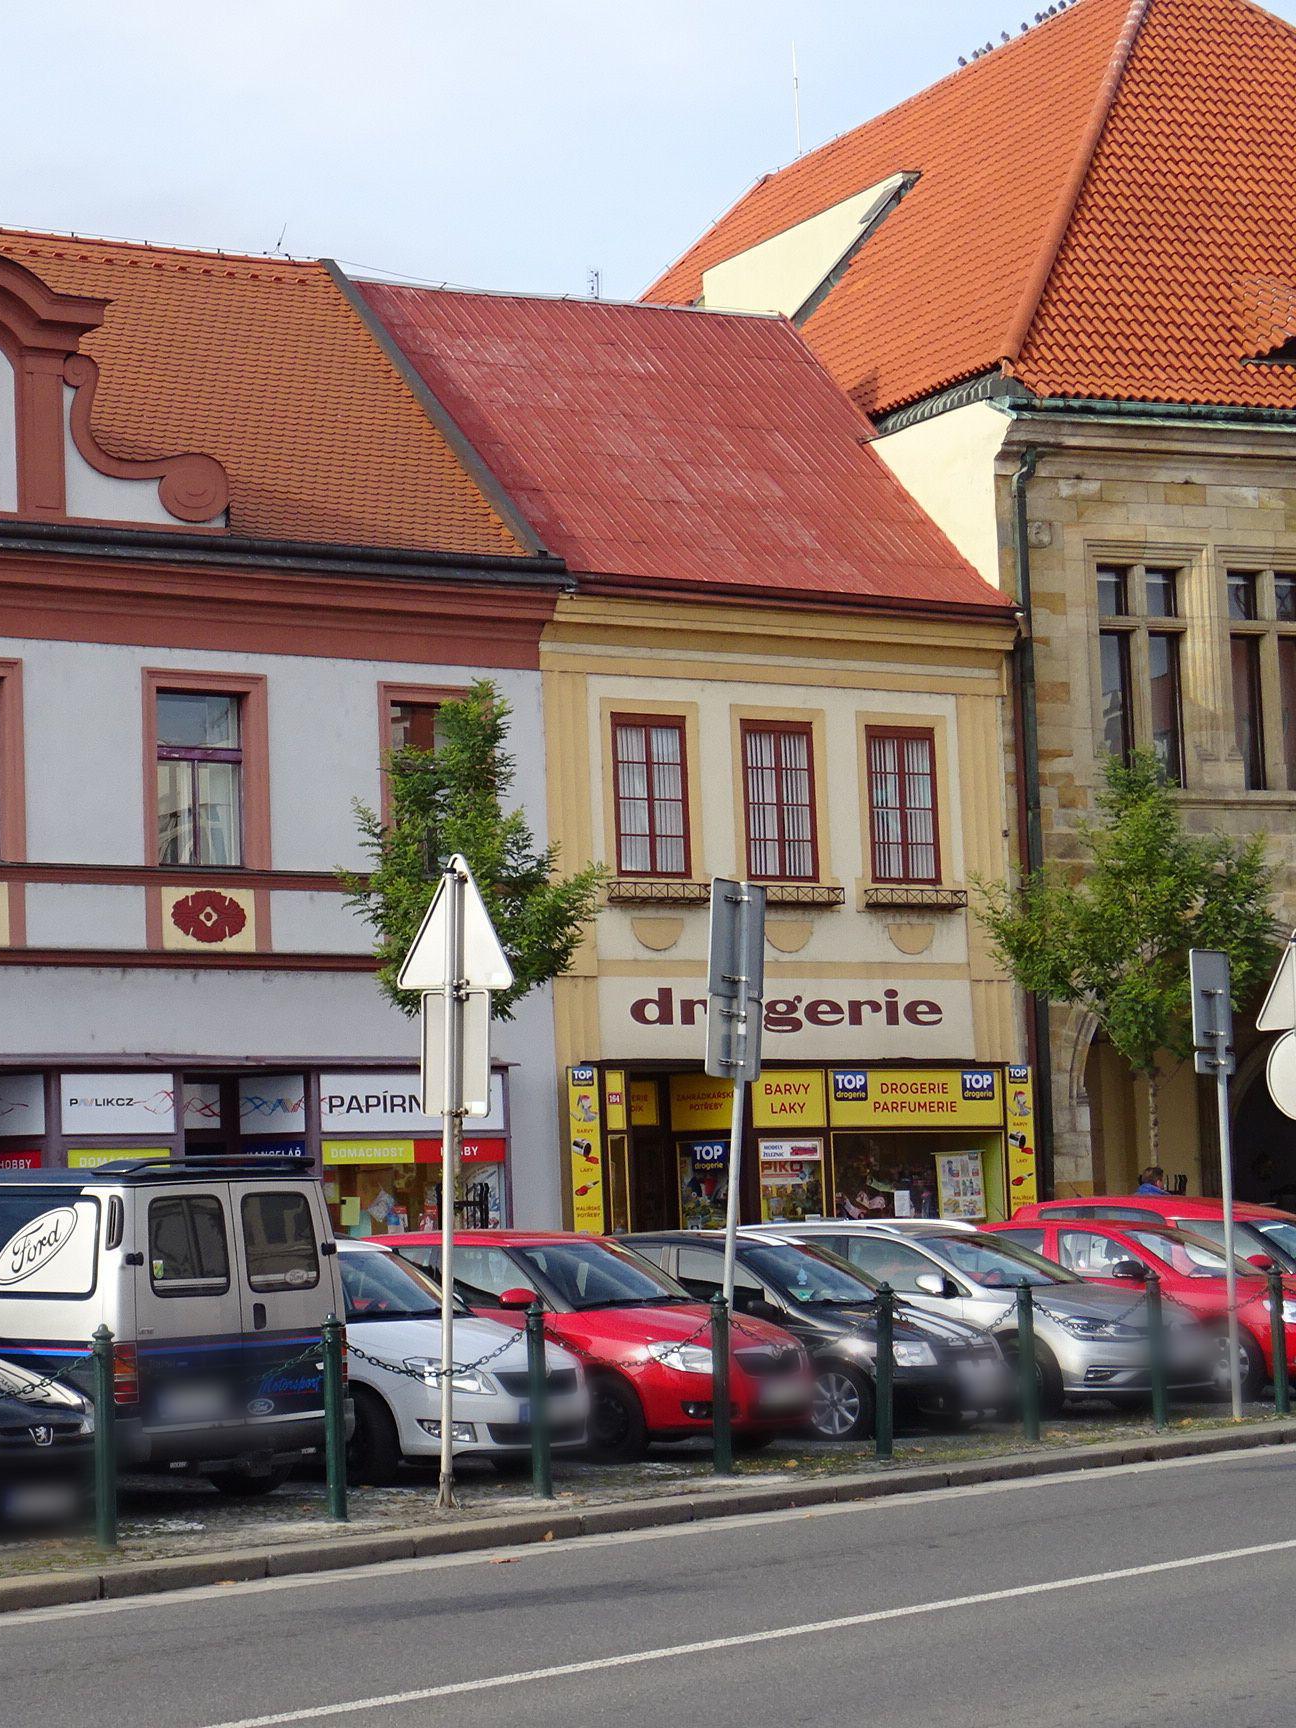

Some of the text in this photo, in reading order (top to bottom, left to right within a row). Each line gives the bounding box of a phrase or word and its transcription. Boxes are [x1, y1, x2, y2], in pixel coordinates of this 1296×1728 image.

[629, 986, 943, 1034] drgerie
[573, 1070, 593, 1080] TOP
[1009, 1068, 1028, 1077] TOP
[835, 1074, 866, 1089] TOP
[963, 1074, 993, 1088] TOP
[764, 1083, 810, 1096] BARVY
[835, 1090, 866, 1100] drogerie
[880, 1082, 949, 1095] DROGERIE
[963, 1089, 993, 1099] drogerie
[327, 1090, 421, 1114] PAPÍRN
[770, 1101, 806, 1114] LAKY
[873, 1101, 958, 1113] PARFUMERIE
[694, 1145, 723, 1160] TOP
[694, 1161, 724, 1171] drogerie
[10, 1218, 63, 1274] Ford
